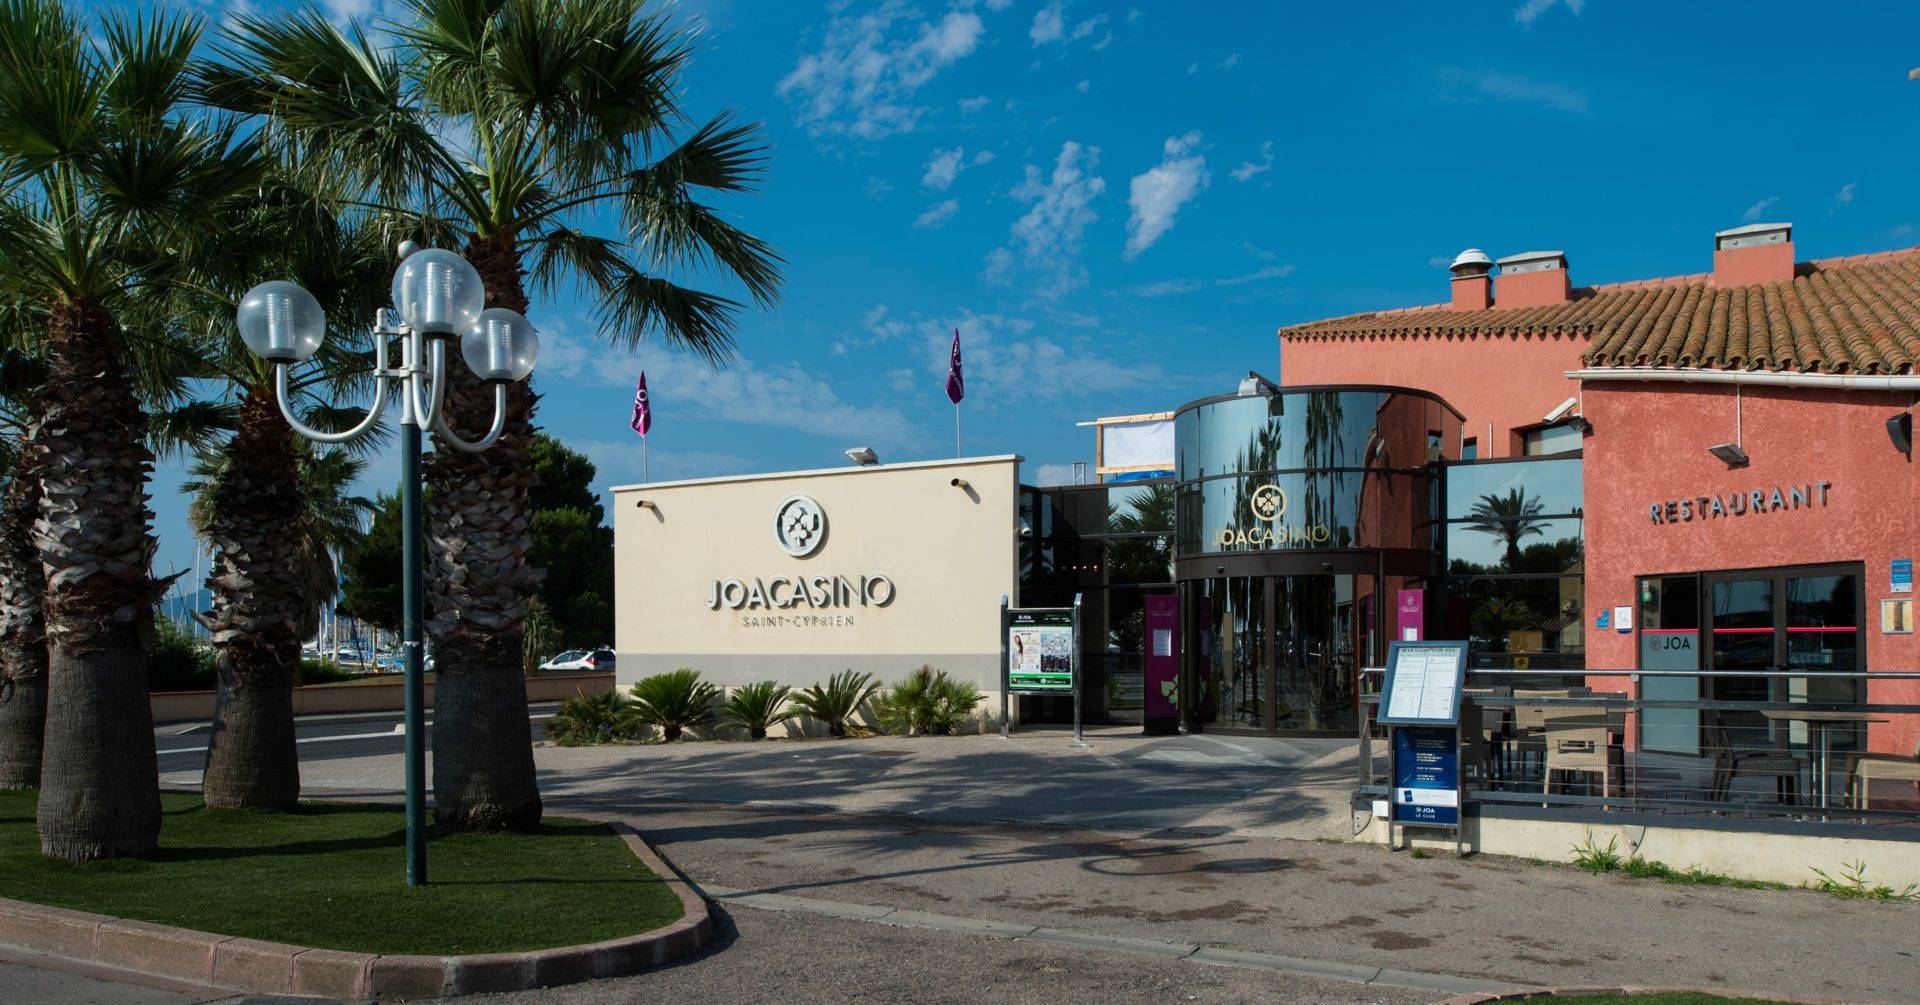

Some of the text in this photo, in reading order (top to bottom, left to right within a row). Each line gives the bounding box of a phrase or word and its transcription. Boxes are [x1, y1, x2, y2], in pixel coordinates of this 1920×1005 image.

[1649, 480, 1832, 525] RESTAURANT
[1212, 525, 1329, 546] JOACASINO
[704, 574, 895, 610] JOACASINO
[742, 615, 855, 628] SAINT-CYPRIEN
[1663, 636, 1691, 650] JOA
